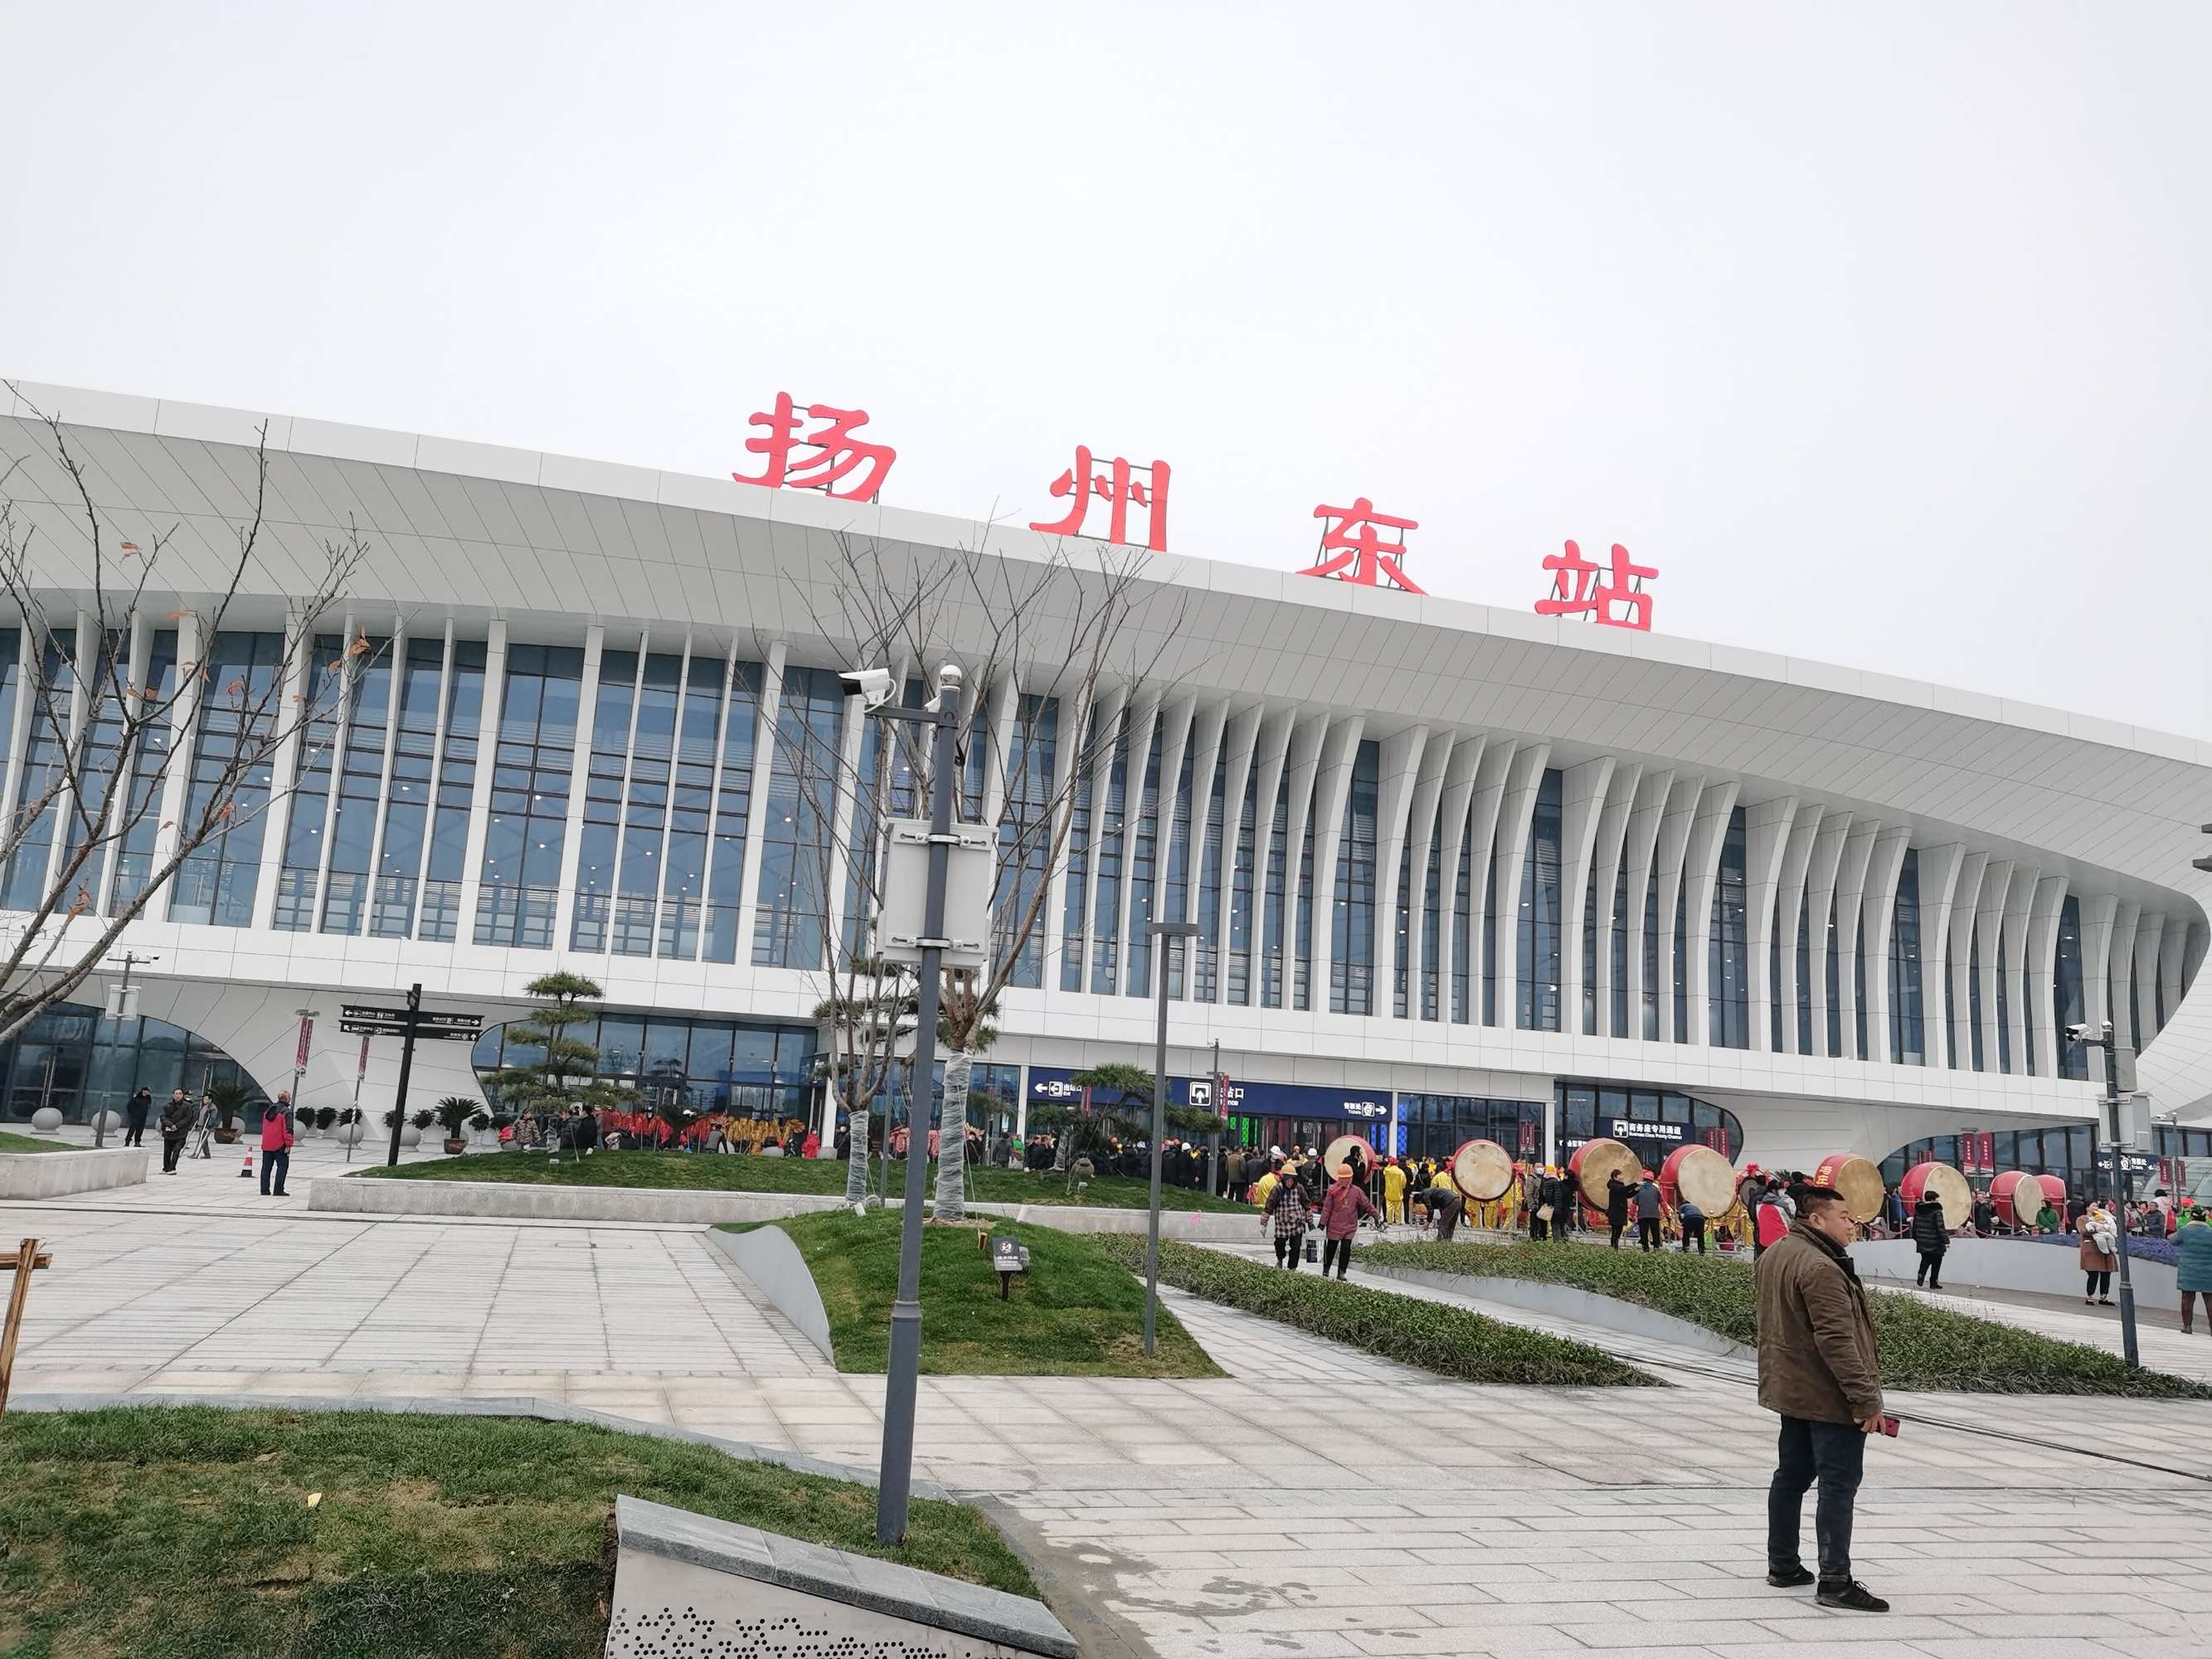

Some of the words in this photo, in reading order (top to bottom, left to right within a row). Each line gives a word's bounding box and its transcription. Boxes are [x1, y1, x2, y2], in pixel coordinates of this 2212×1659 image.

[734, 392, 1658, 631] 扬州东站
[1628, 1122, 1681, 1136] 商务座专用通道
